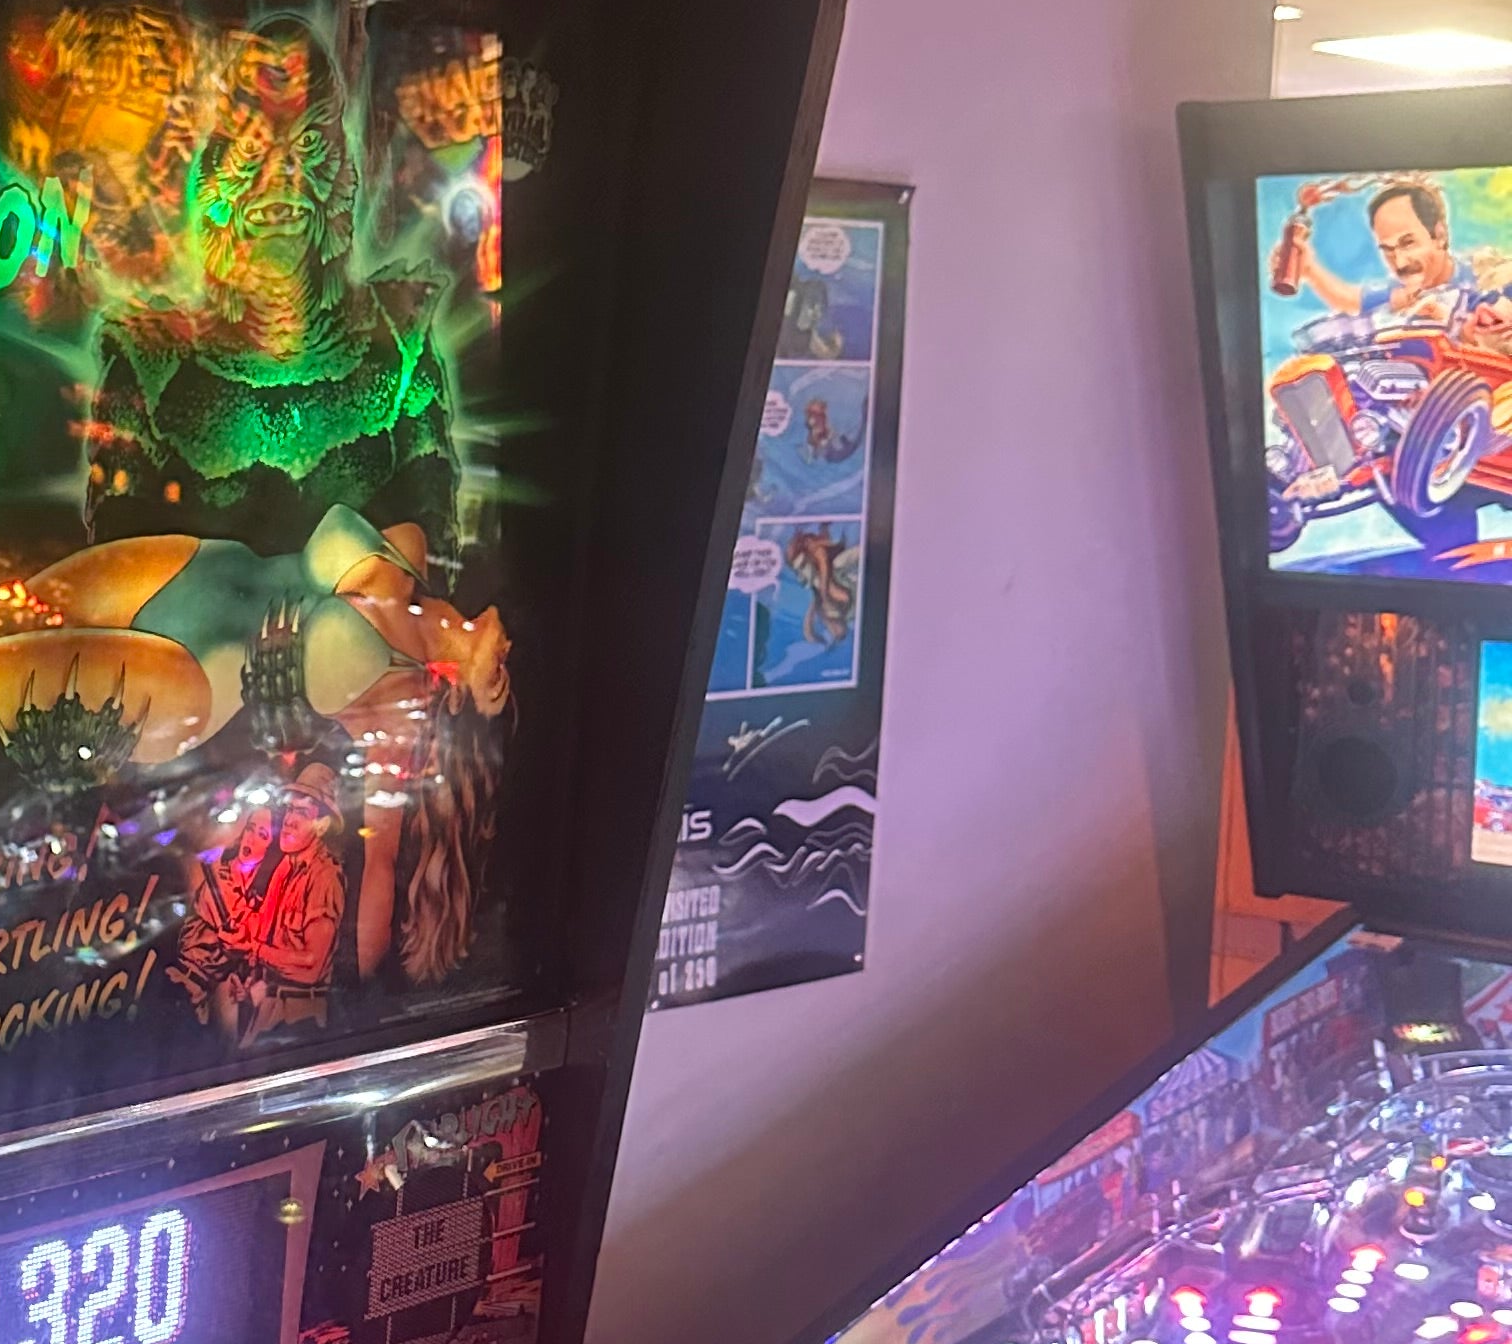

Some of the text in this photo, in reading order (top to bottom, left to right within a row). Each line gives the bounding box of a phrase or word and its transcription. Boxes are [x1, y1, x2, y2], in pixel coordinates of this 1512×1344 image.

[657, 921, 717, 959] DITION
[413, 1218, 446, 1250] THE
[379, 1257, 469, 1303] CREATURE
